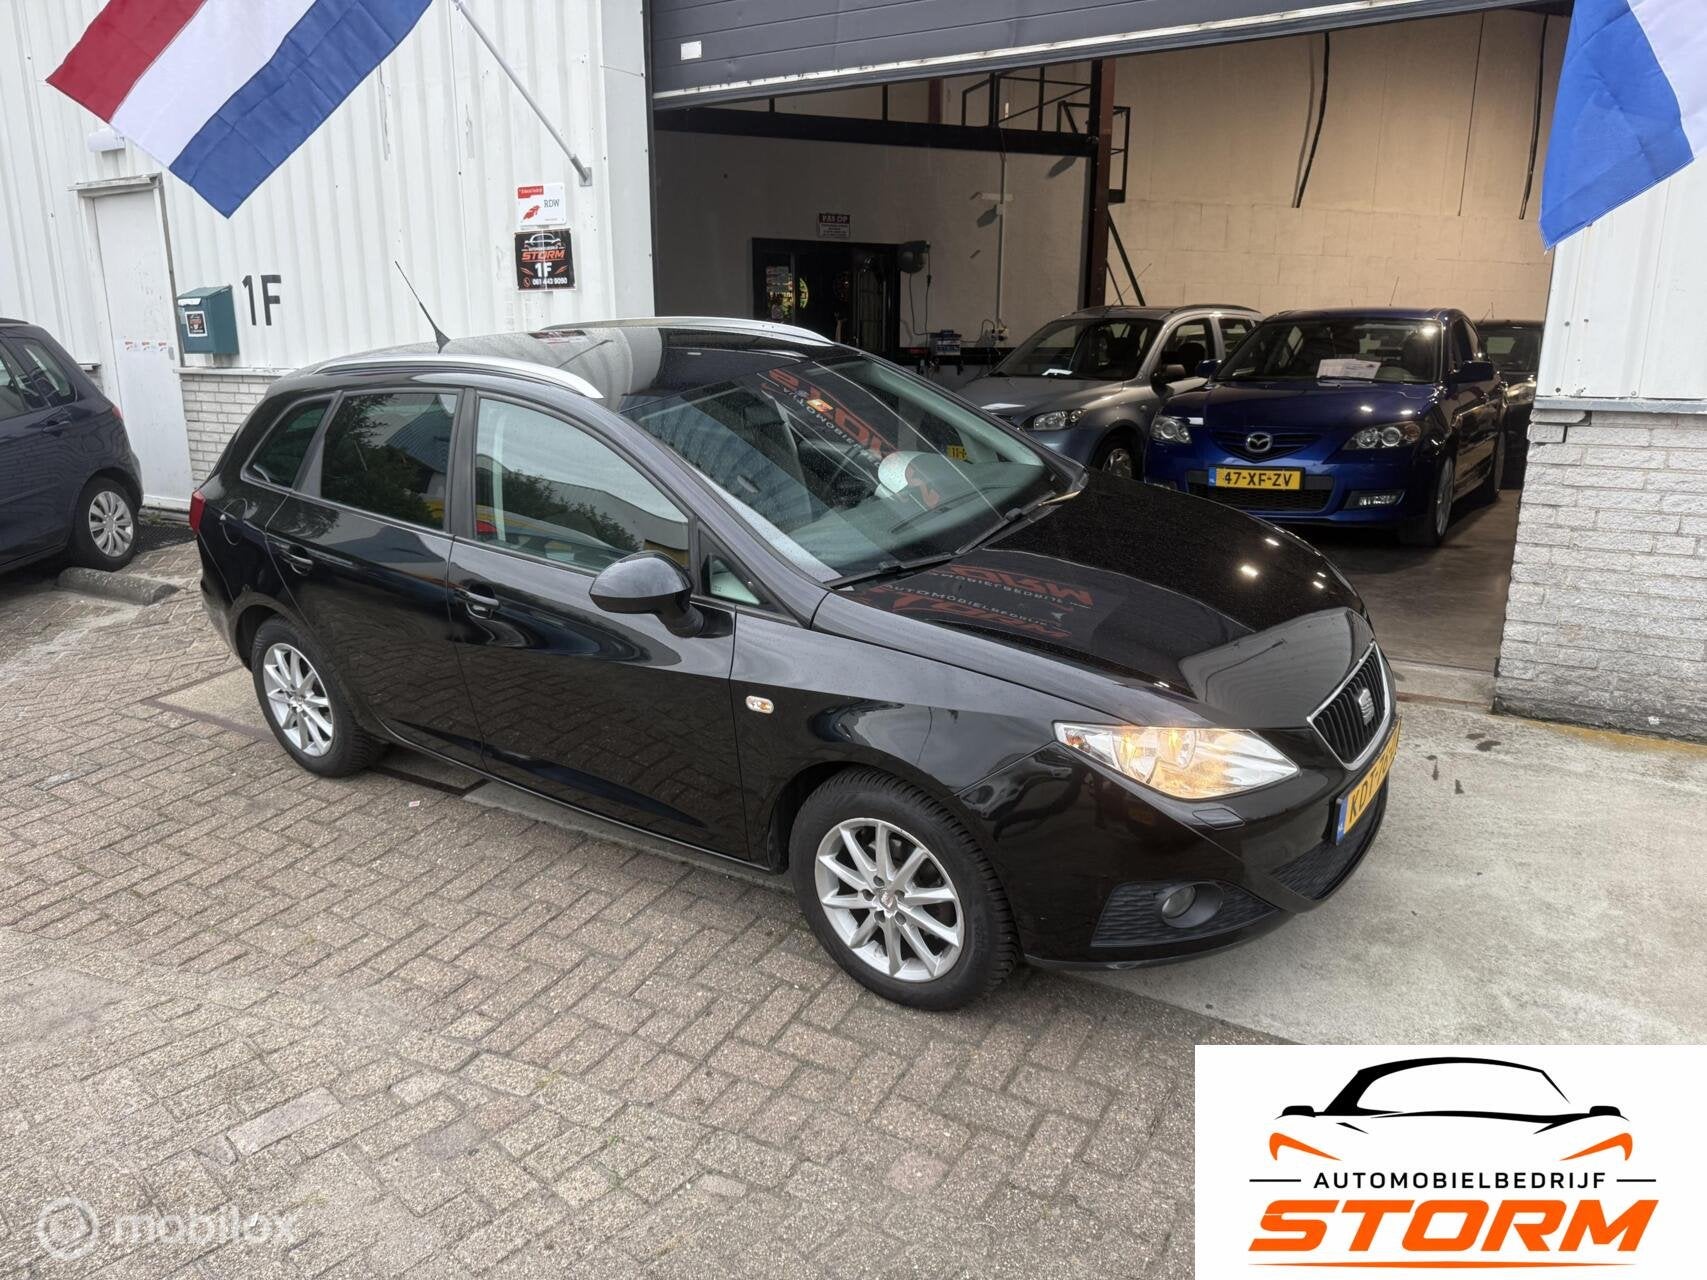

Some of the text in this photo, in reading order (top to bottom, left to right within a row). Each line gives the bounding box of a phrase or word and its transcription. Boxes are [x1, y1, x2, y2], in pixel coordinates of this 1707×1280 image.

[543, 199, 560, 208] RDW
[521, 249, 566, 261] STORM
[535, 261, 552, 278] 1F
[242, 274, 282, 326] 1F
[1224, 471, 1293, 487] 47-XF-ZV
